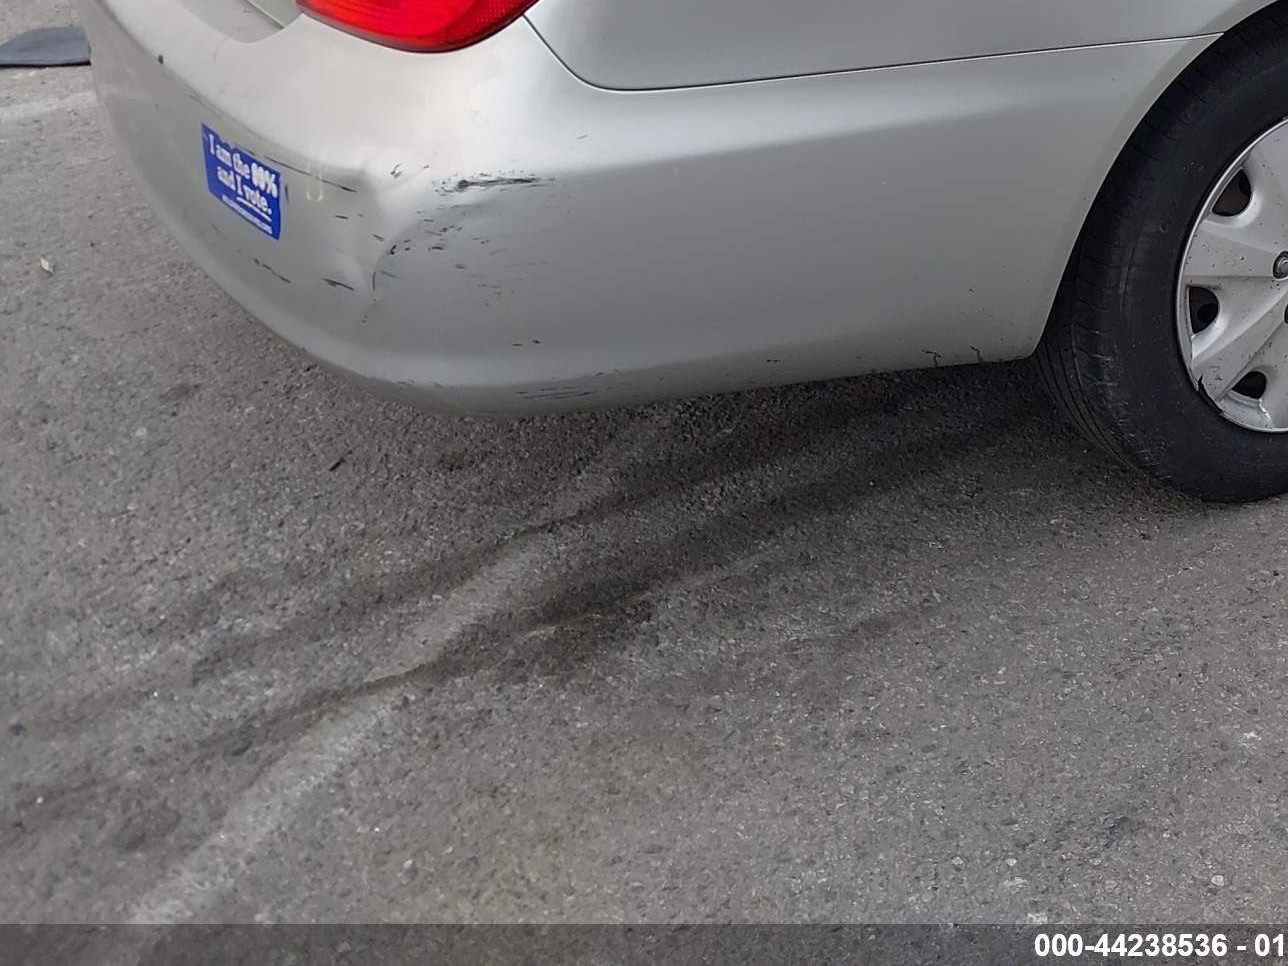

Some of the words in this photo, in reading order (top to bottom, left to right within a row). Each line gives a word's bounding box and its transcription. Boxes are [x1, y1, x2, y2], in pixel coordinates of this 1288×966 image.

[208, 134, 215, 154] I
[215, 144, 232, 166] am
[233, 153, 250, 179] the
[217, 166, 235, 191] and
[236, 175, 243, 195] I
[243, 185, 272, 215] vote.
